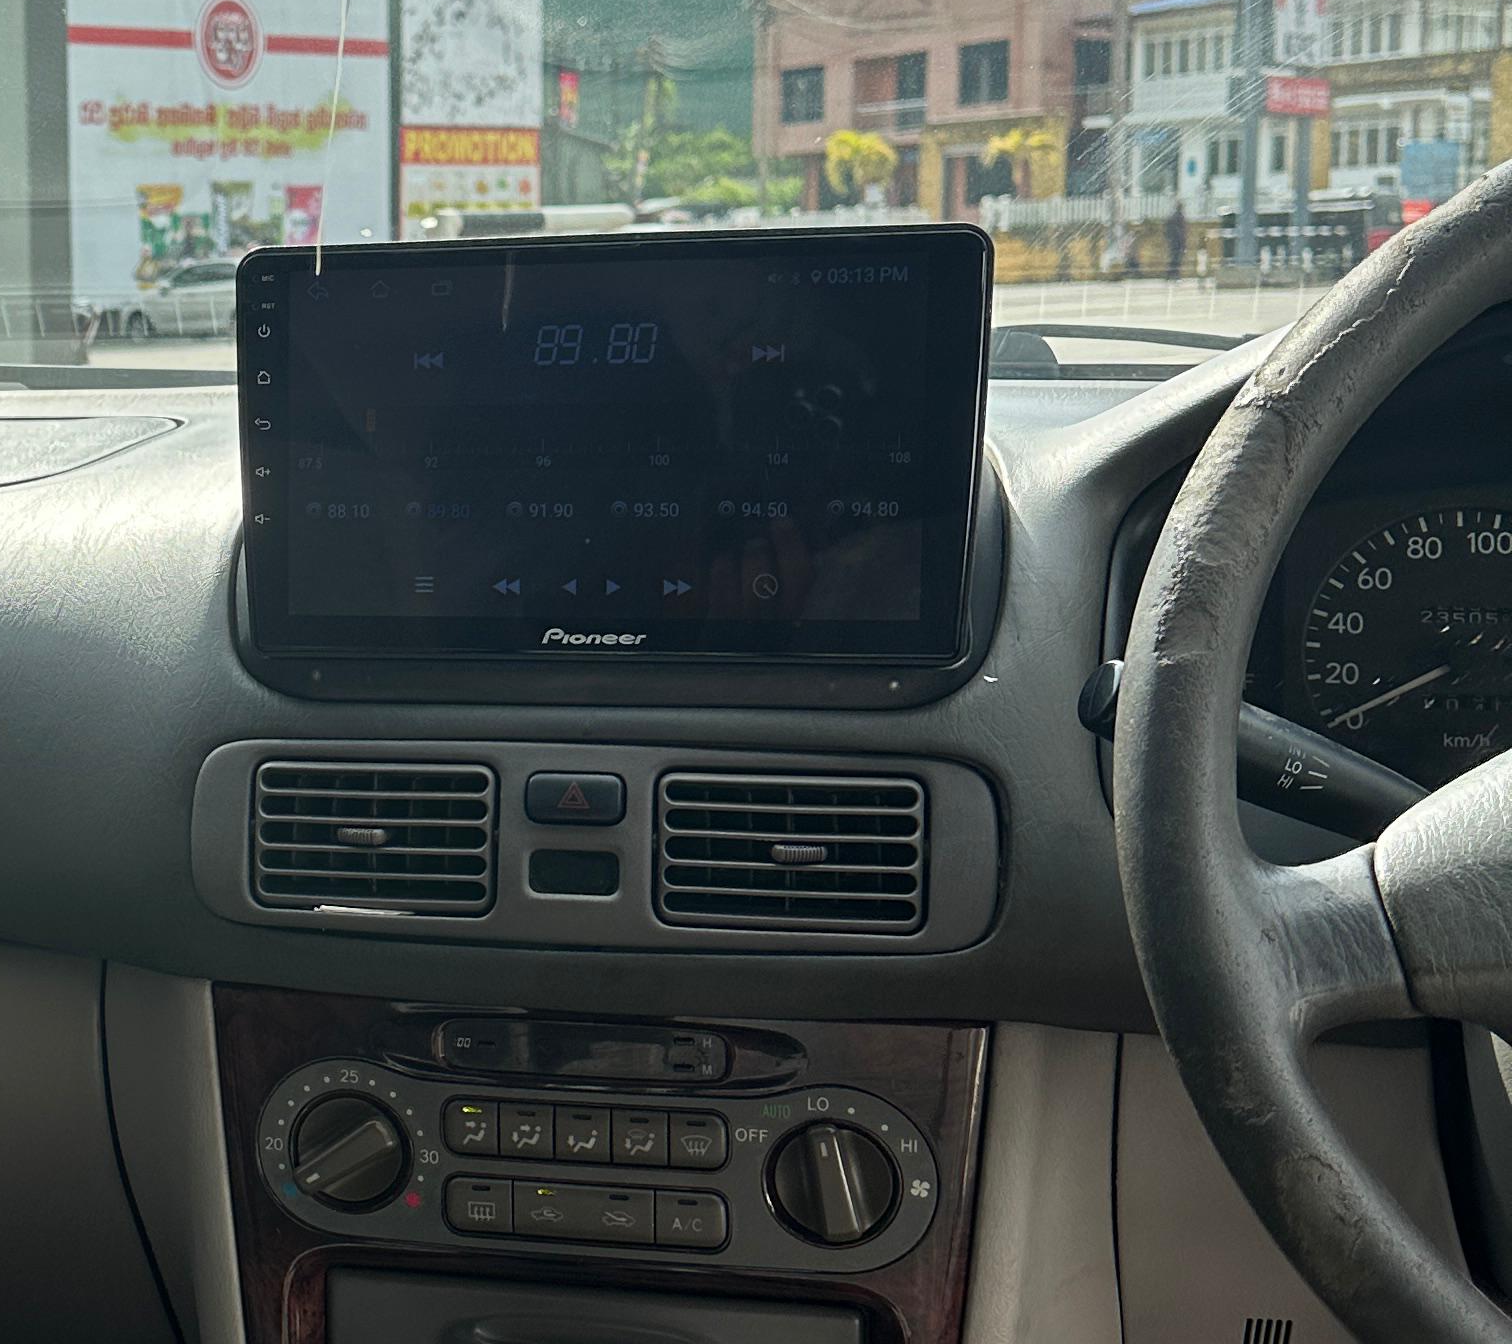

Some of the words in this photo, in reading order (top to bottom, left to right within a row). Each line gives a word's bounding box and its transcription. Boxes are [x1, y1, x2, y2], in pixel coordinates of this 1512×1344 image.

[829, 267, 874, 284] 03:13
[878, 266, 909, 283] PM
[533, 322, 659, 366] 89.80
[528, 502, 574, 518] 91.90
[633, 502, 681, 518] 93.50
[741, 501, 788, 517] 94.50
[851, 501, 900, 517] 94.80
[1406, 536, 1443, 560] 80
[1466, 530, 1512, 555] 100
[1356, 567, 1393, 590] 60
[1327, 611, 1364, 636] 40
[541, 627, 648, 647] Pioneer
[1325, 662, 1360, 685] 20
[1345, 706, 1365, 731] 0
[1284, 757, 1303, 774] LO
[1277, 773, 1294, 789] HI
[702, 1037, 713, 1049] H
[339, 1069, 360, 1084] 25
[701, 1063, 713, 1076] M
[762, 1104, 791, 1119] AUTO
[806, 1096, 831, 1112] LO
[264, 1136, 284, 1151] 20
[734, 1128, 769, 1144] OFF
[900, 1138, 919, 1153] HI
[419, 1148, 440, 1165] 30
[672, 1216, 703, 1233] A/C
